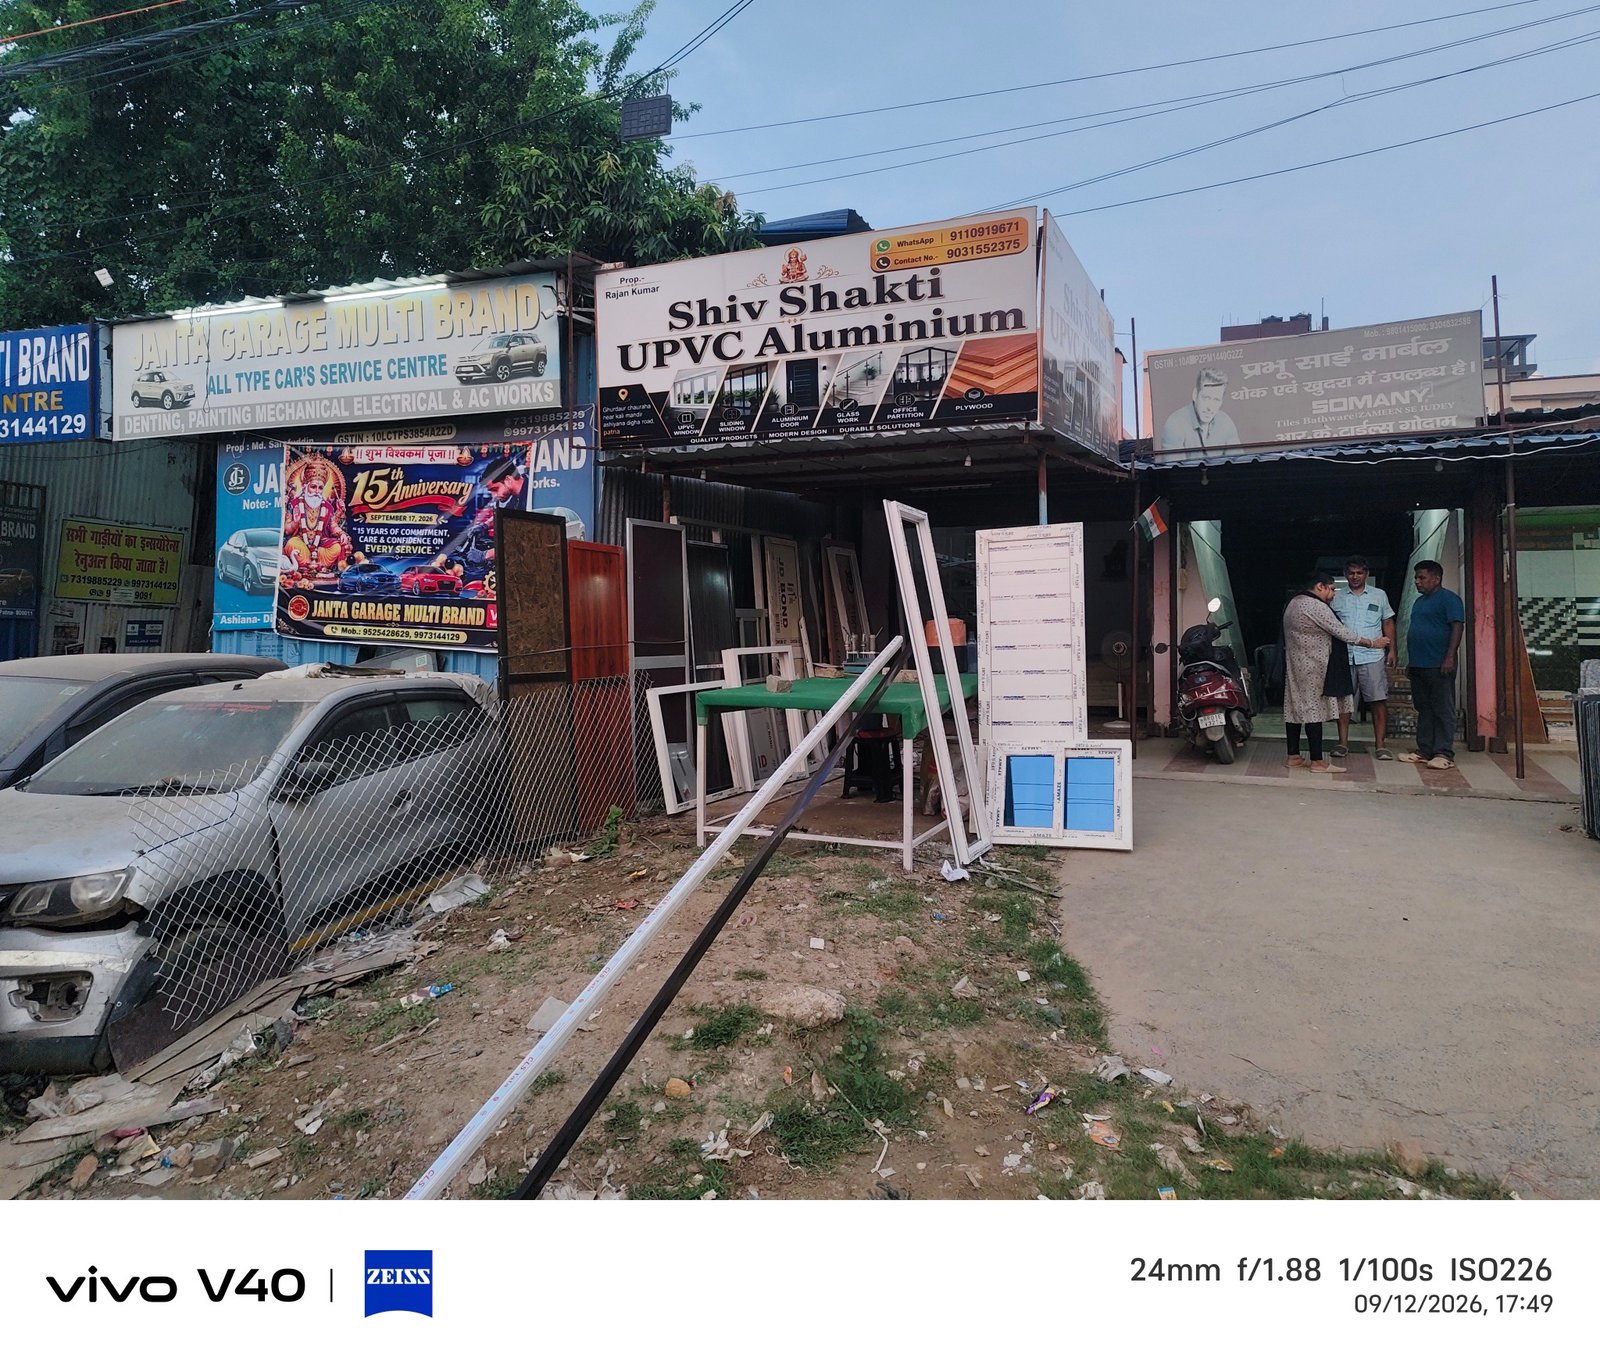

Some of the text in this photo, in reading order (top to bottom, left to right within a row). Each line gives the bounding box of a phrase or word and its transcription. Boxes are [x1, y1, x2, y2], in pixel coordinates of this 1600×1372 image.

[897, 222, 1020, 248] WhatsApp 9110919671
[894, 255, 922, 266] Contact
[947, 239, 1021, 258] 9031552375
[605, 286, 660, 301] Rajan Kumar
[668, 268, 944, 331] Shiv Shakti
[133, 283, 541, 371] JANTA GARAGE MULTI BRAND
[617, 307, 1027, 372] UPVC Aluminium
[1361, 336, 1452, 362] मार्बल
[18, 332, 90, 386] BRAND
[207, 353, 448, 396] ALL TYPE CAR'S SERVICE CENTRE
[124, 381, 555, 435] DENTING, PAINTING MECHANICAL ELECTRICAL & AC WORKS
[892, 406, 918, 414] OFFICE
[955, 403, 993, 411] PLYWOOD
[1312, 388, 1430, 415] SOMANY
[771, 415, 809, 423] ALUMINIUM
[886, 411, 924, 419] PARTITION
[337, 432, 365, 443] GSTIN
[690, 421, 921, 444] QUALITY PRODUCTS MODERN DESIGN DURABLE SOLUTIONS
[226, 444, 244, 453] Prop
[251, 441, 266, 451] Md.
[365, 449, 382, 461] शुभ
[427, 449, 446, 462] पूजा
[389, 479, 474, 506] Anniversary
[242, 498, 272, 511] Note:-
[370, 513, 434, 523] SEPTEMBER 17, 2026
[1, 521, 36, 539] BRAND
[66, 525, 87, 544] सभी
[125, 534, 137, 549] का
[365, 527, 388, 535] YEARS
[389, 527, 400, 536] OF
[400, 528, 450, 538] COMMITMENT,
[358, 535, 444, 545] CARE & CONFIDENCE ON
[365, 544, 394, 554] EVERY
[111, 553, 133, 571] किया
[136, 559, 158, 573] जाता
[70, 575, 177, 591] 7319885229 9973144129
[220, 614, 261, 625] Ashiana-
[312, 600, 348, 619] JANTA
[351, 601, 401, 622] GARAGE
[404, 603, 441, 623] MULTI
[442, 605, 485, 626] BRAND
[362, 629, 412, 639] 9525428629,
[414, 631, 460, 641] 9973144129
